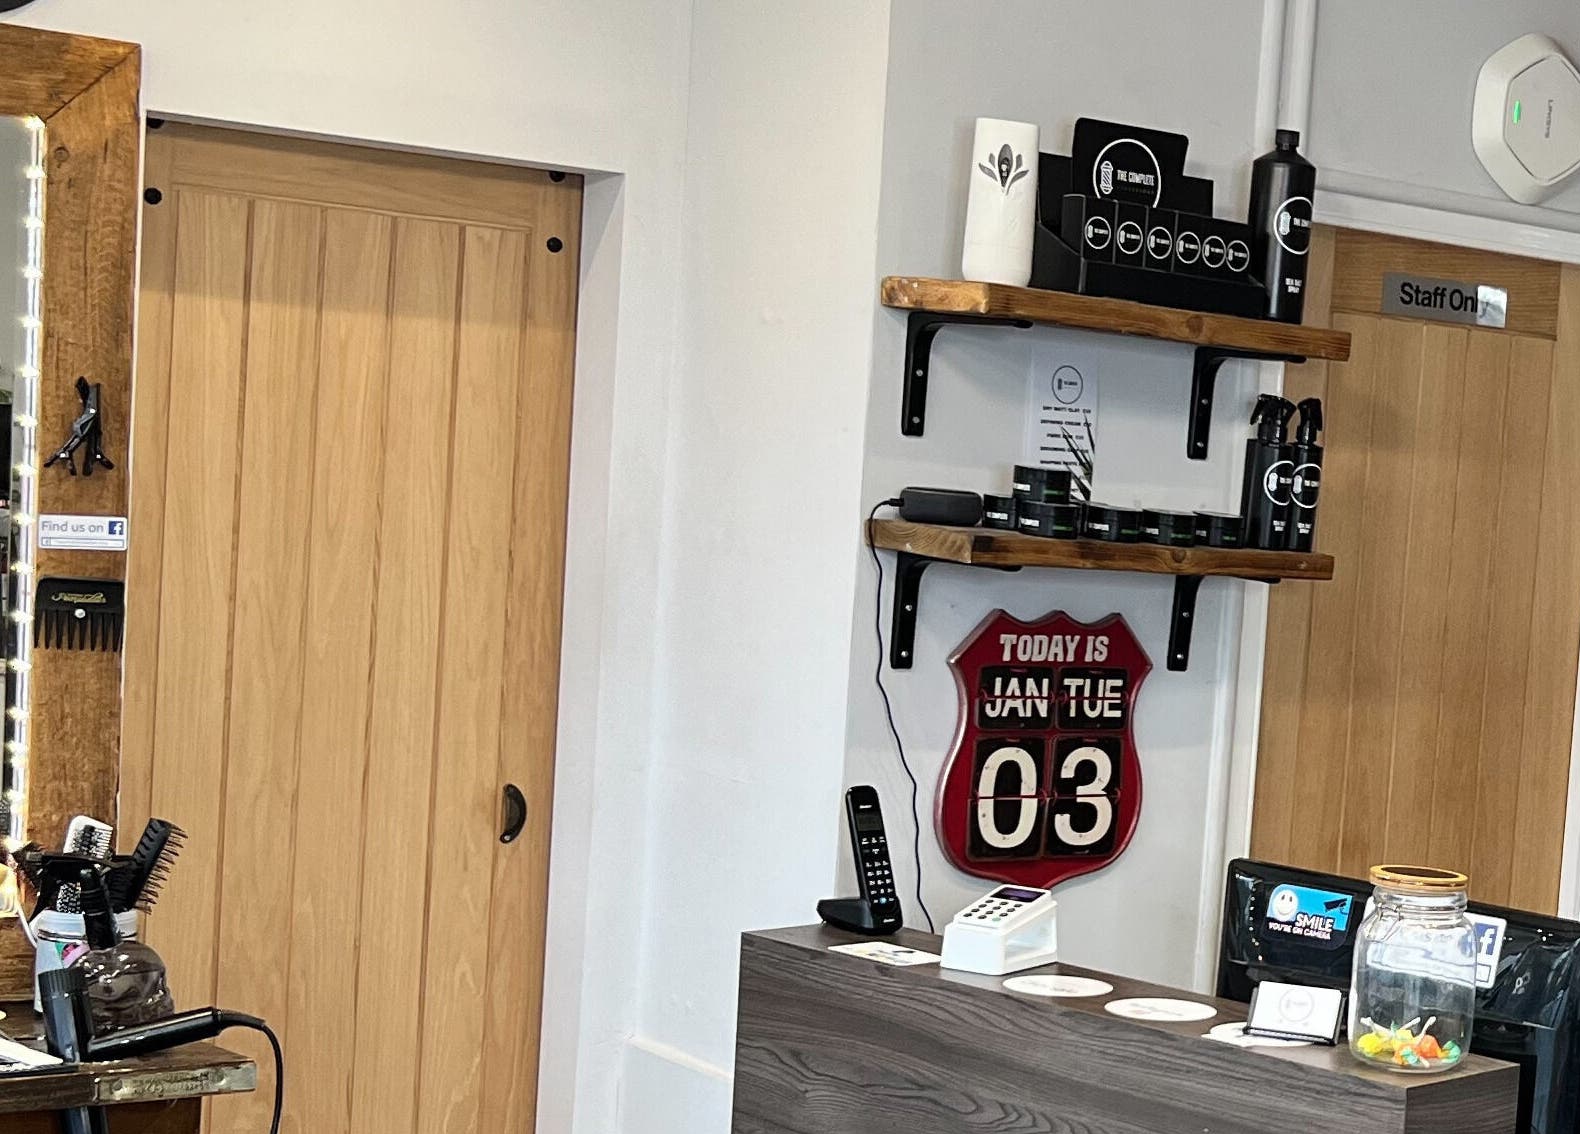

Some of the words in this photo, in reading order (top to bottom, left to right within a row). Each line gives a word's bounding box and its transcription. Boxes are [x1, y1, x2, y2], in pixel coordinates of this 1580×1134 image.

[1399, 282, 1447, 309] Staff
[1449, 289, 1490, 319] Only
[41, 520, 68, 532] Find
[71, 523, 86, 532] us
[88, 523, 104, 533] on
[1000, 634, 1080, 662] TODAY
[1085, 635, 1109, 662] IS
[985, 677, 1049, 718] JAN
[1063, 678, 1124, 718] TUE
[1295, 913, 1334, 932] SMILE
